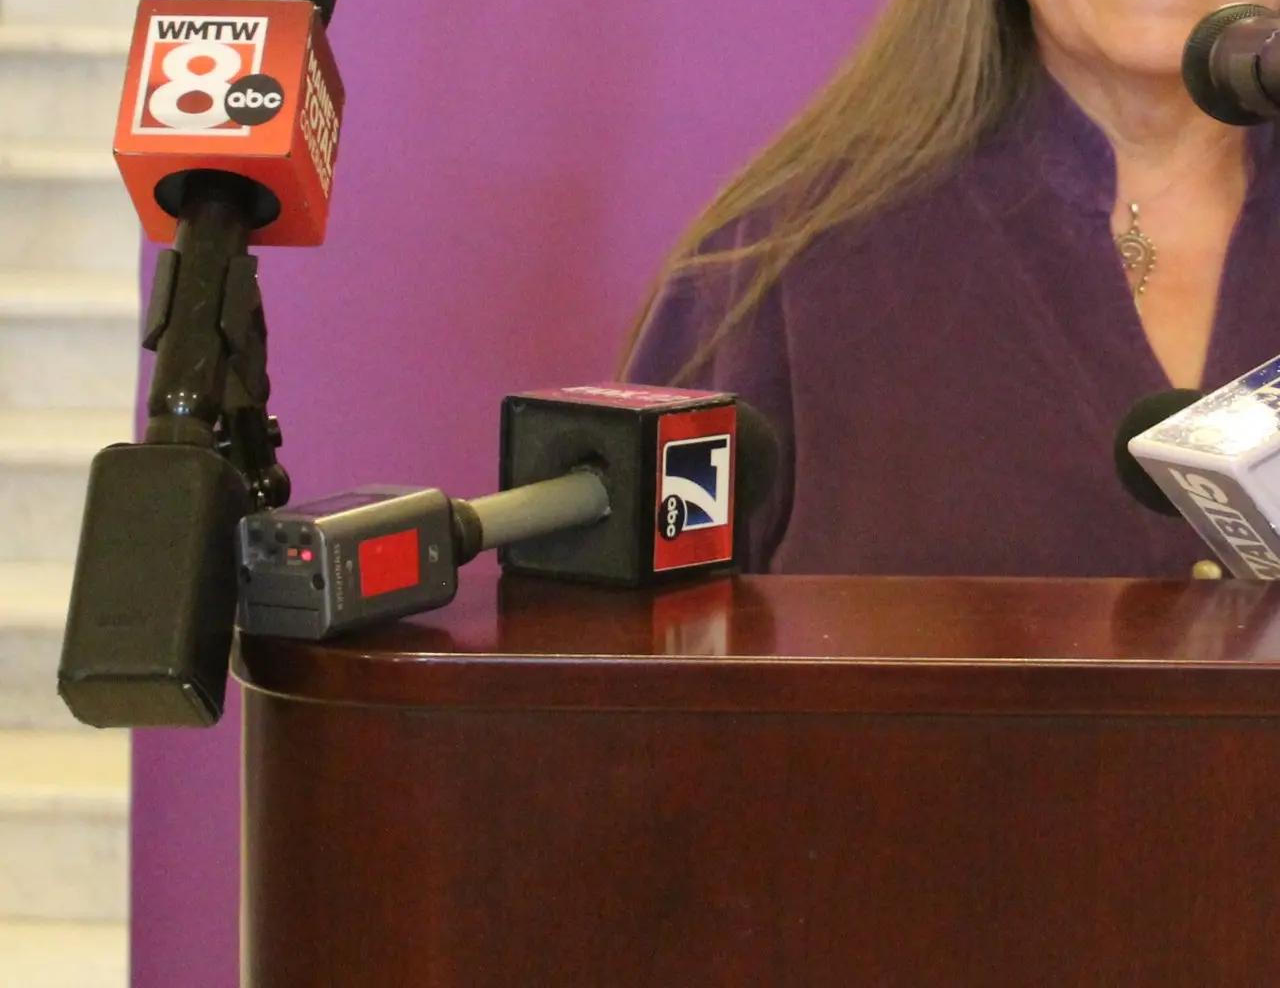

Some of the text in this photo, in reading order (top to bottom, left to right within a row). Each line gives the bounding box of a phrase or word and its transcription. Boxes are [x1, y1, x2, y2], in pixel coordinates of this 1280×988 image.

[158, 20, 259, 40] WMTW
[149, 42, 242, 129] 8
[227, 89, 282, 109] abc
[305, 74, 332, 177] TOTAL
[666, 496, 679, 538] abc
